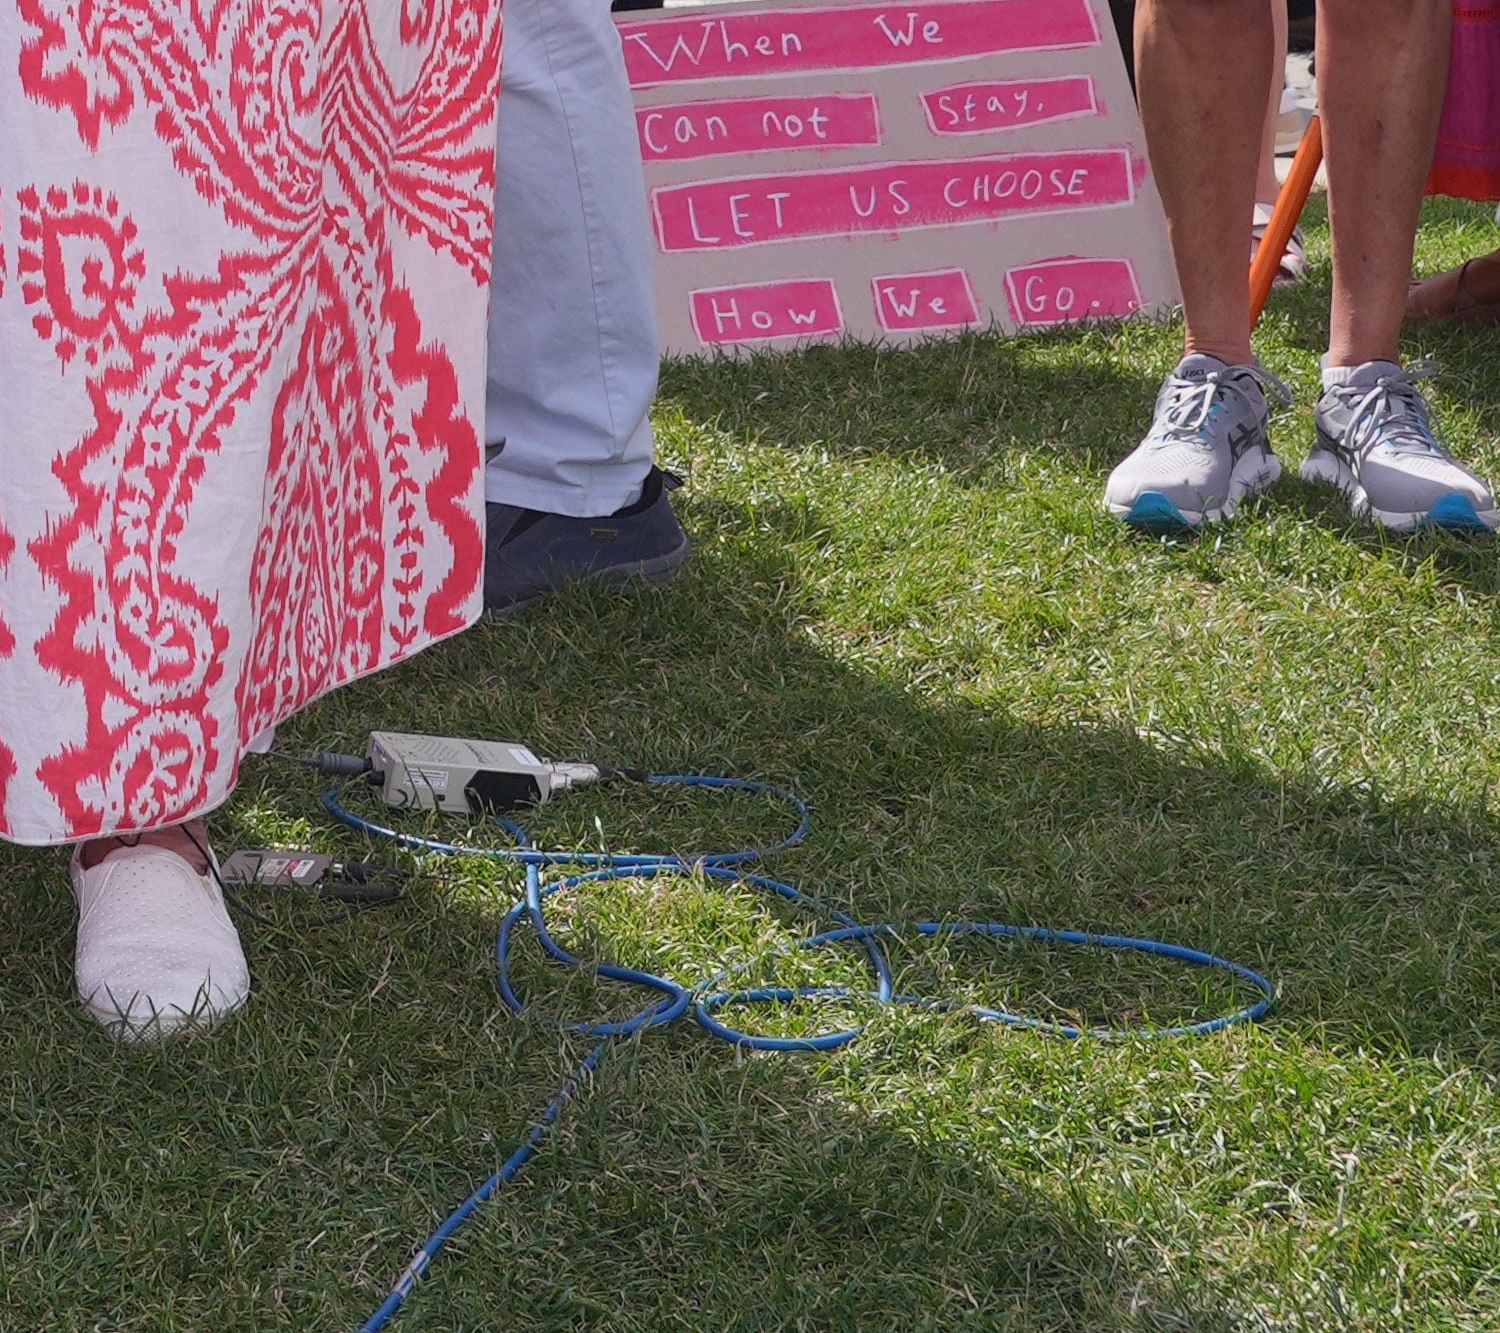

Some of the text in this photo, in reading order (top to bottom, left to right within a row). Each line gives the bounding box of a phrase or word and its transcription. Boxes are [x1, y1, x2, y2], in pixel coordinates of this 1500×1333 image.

[625, 12, 944, 72] When We
[643, 111, 728, 153] Can
[762, 106, 830, 139] not
[688, 168, 1090, 242] LET US CHOOSE
[711, 296, 817, 331] How
[882, 286, 946, 318] We
